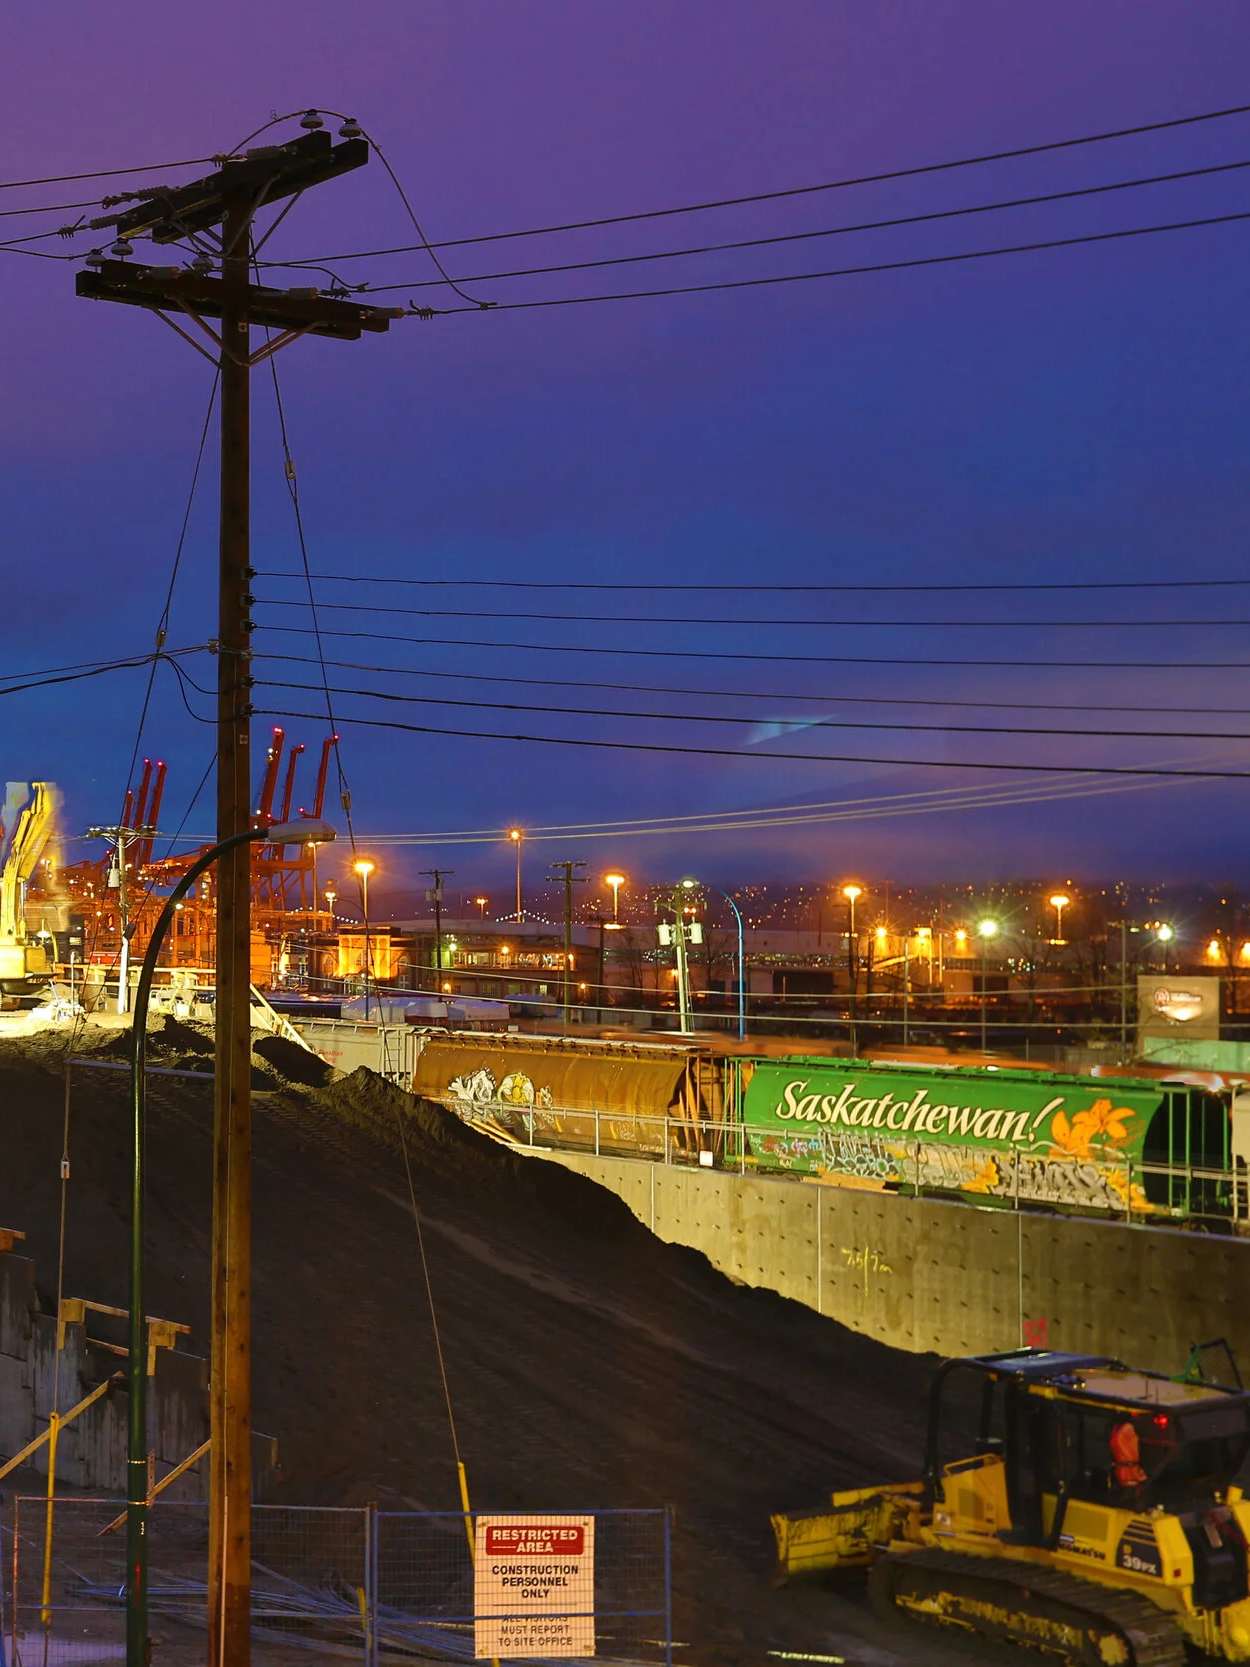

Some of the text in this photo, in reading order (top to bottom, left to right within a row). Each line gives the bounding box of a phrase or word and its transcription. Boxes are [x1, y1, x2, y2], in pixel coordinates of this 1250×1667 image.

[775, 1080, 1065, 1142] Saskatchewan!
[492, 1529, 578, 1541] RESTRICTED
[516, 1541, 554, 1553] AREA
[492, 1565, 579, 1575] CONSTRUCTION
[502, 1576, 568, 1587] PERSONNEL
[521, 1588, 550, 1599] ONLY
[501, 1625, 570, 1635] MUST REPORT
[498, 1636, 573, 1646] TO SITE OFFICE
